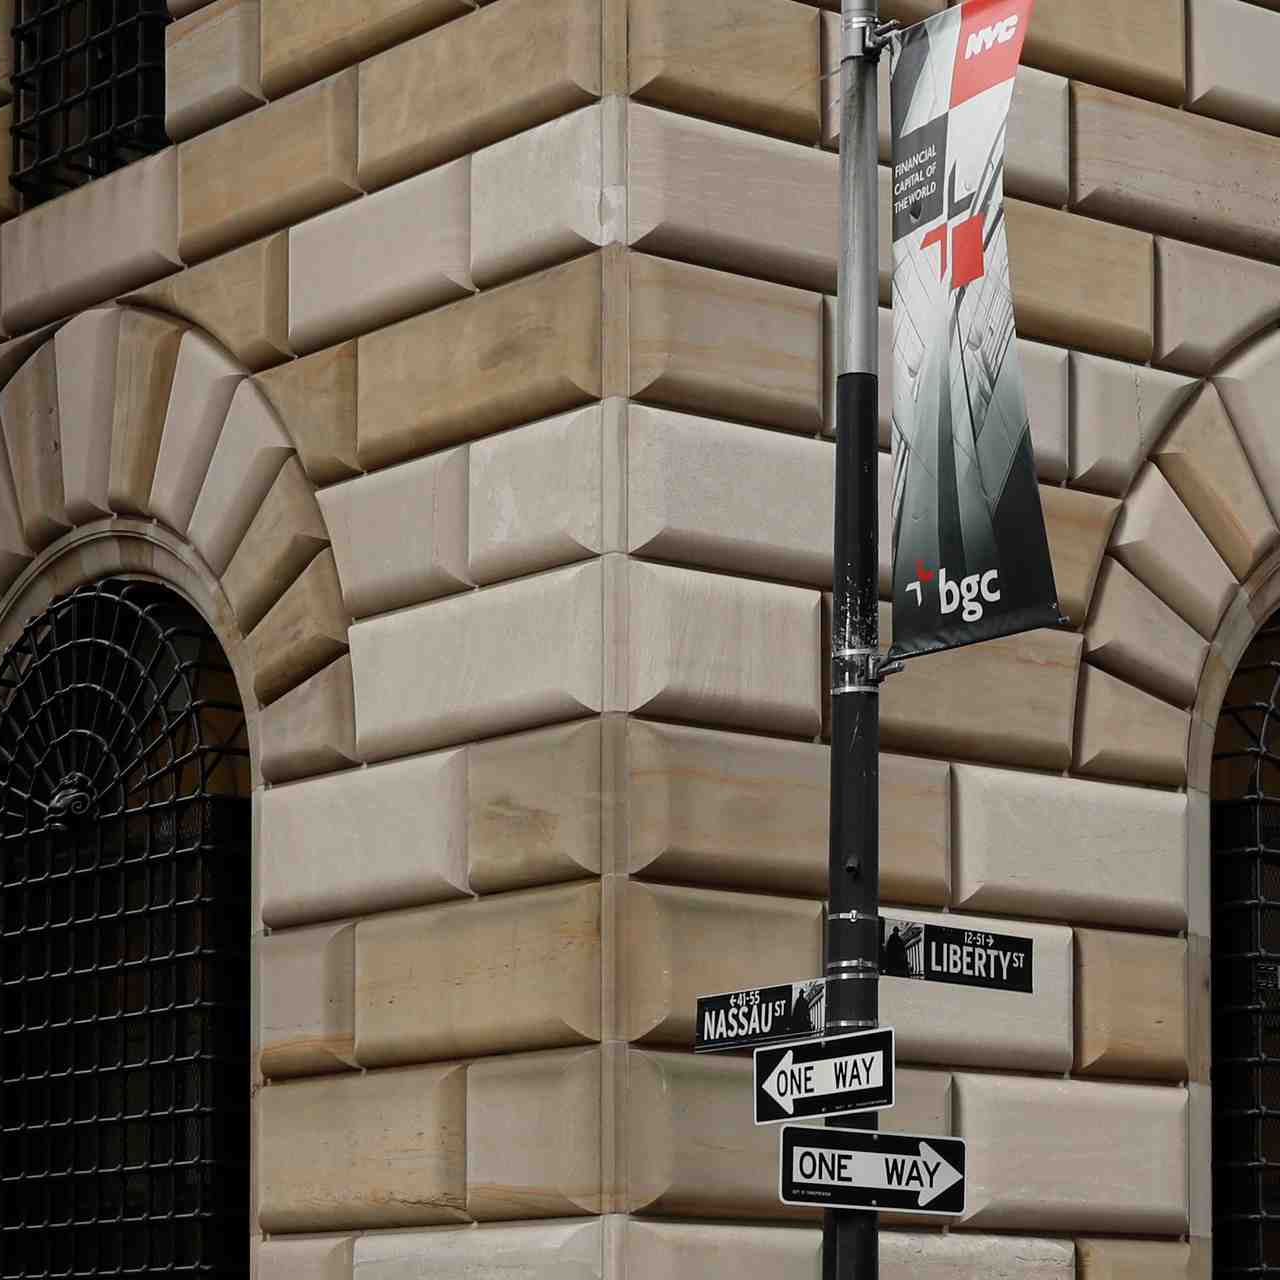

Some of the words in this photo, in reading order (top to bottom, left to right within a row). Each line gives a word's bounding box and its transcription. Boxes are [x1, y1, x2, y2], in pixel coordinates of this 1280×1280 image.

[964, 14, 1019, 60] NYC
[894, 169, 925, 196] CAPITAL
[926, 161, 937, 178] OF
[895, 143, 937, 178] FINANCIAL
[894, 197, 910, 214] THE
[909, 181, 937, 205] WORLD
[939, 567, 1001, 622] bgc
[964, 931, 985, 946] 12-51
[930, 941, 1011, 981] LIBERTY
[1012, 952, 1025, 968] ST
[703, 1003, 773, 1041] NASSAU
[774, 1000, 786, 1017] ST
[775, 1065, 815, 1097] ONE
[833, 1056, 875, 1089] WAY
[798, 1150, 853, 1182] ONE
[884, 1157, 941, 1188] WAY
